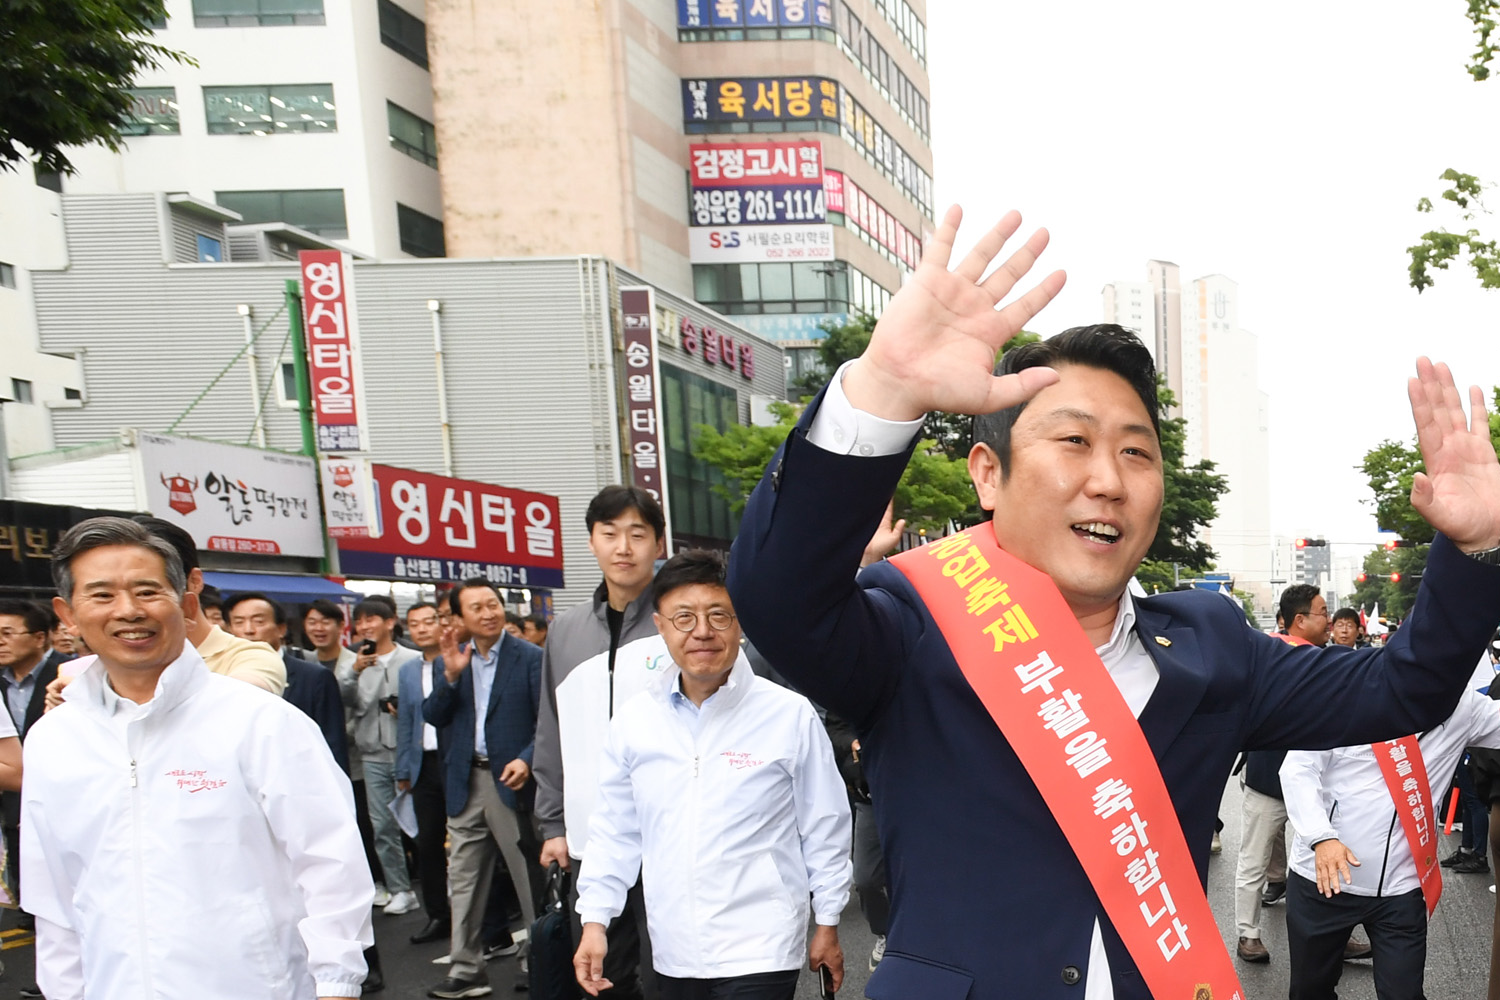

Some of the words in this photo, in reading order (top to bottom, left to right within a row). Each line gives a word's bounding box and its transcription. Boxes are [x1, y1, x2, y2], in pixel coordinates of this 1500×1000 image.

[718, 80, 813, 118] 육서당
[693, 147, 797, 179] 검정고시
[799, 146, 819, 178] 학원
[693, 189, 741, 225] 청운당
[744, 188, 825, 221] 261-1114
[305, 262, 353, 415] 영신타올
[390, 479, 555, 558] 영신타올
[393, 556, 442, 579] 울산본점
[1013, 650, 1113, 779] 부활을
[1090, 777, 1192, 963] 축하합니다
